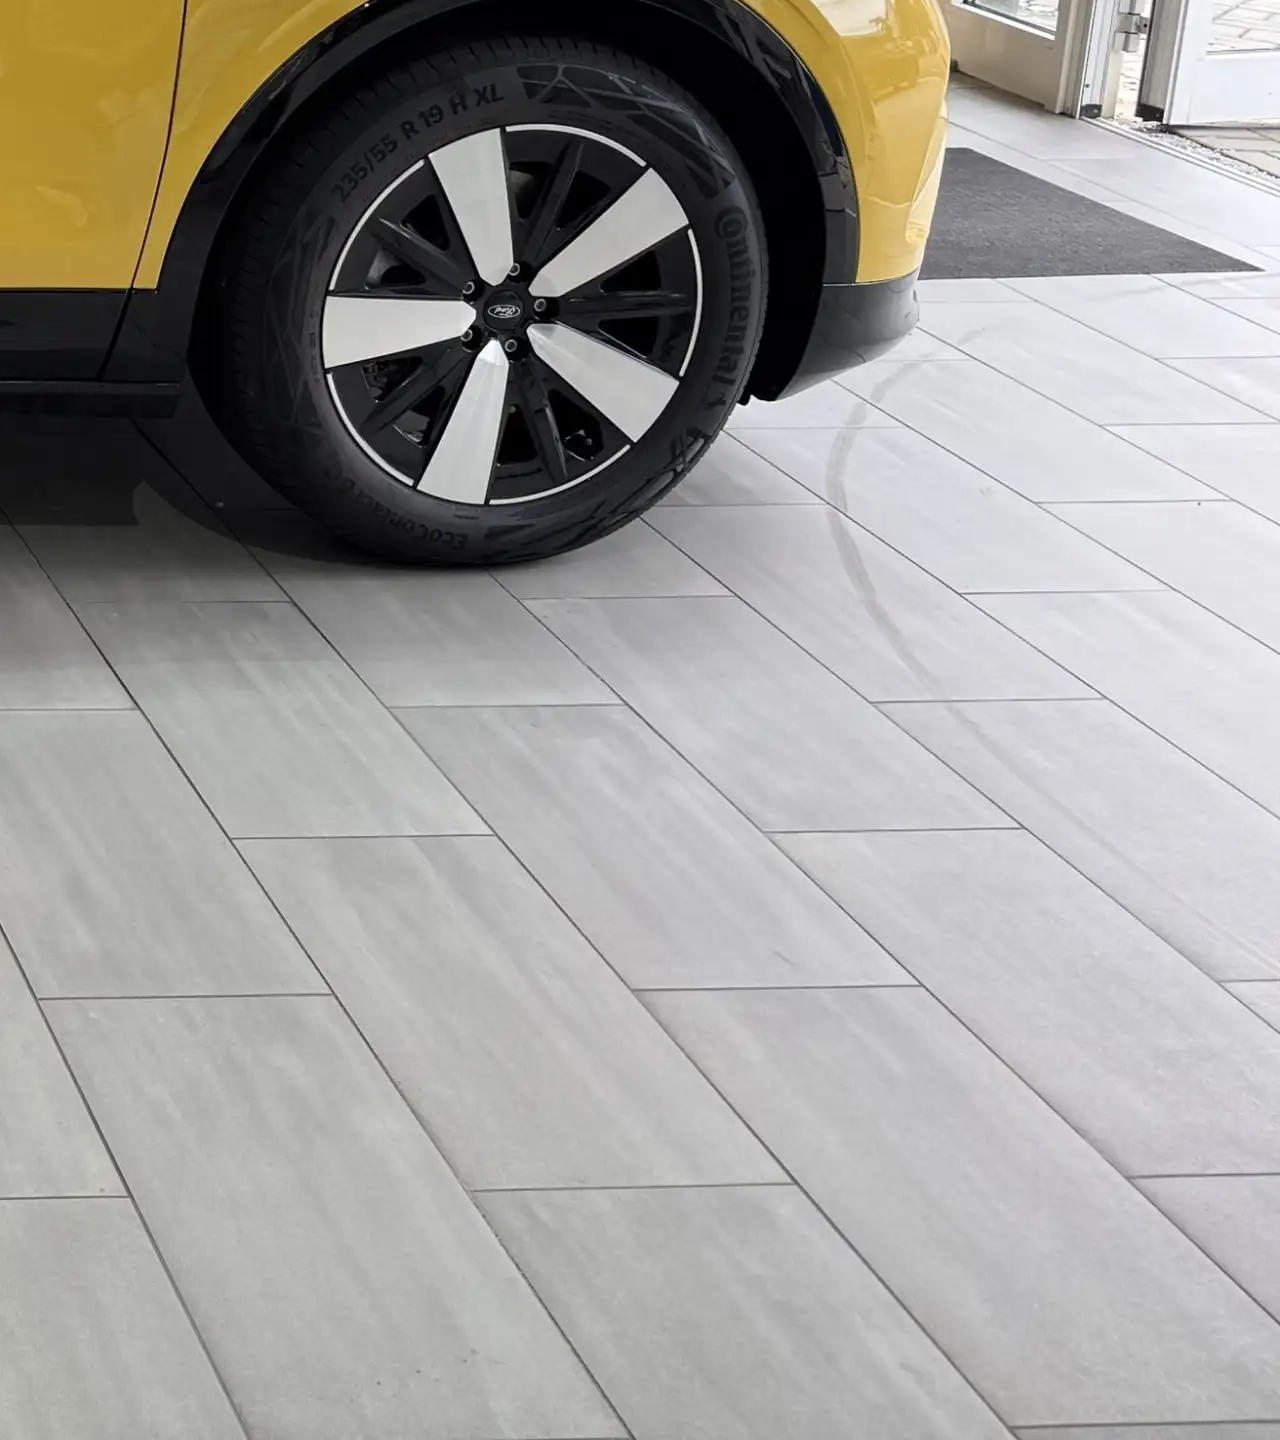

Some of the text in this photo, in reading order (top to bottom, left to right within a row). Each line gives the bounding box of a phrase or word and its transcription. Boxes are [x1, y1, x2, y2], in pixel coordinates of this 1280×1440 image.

[332, 83, 504, 202] 235/55 R 19 H XL
[714, 205, 756, 386] Continental
